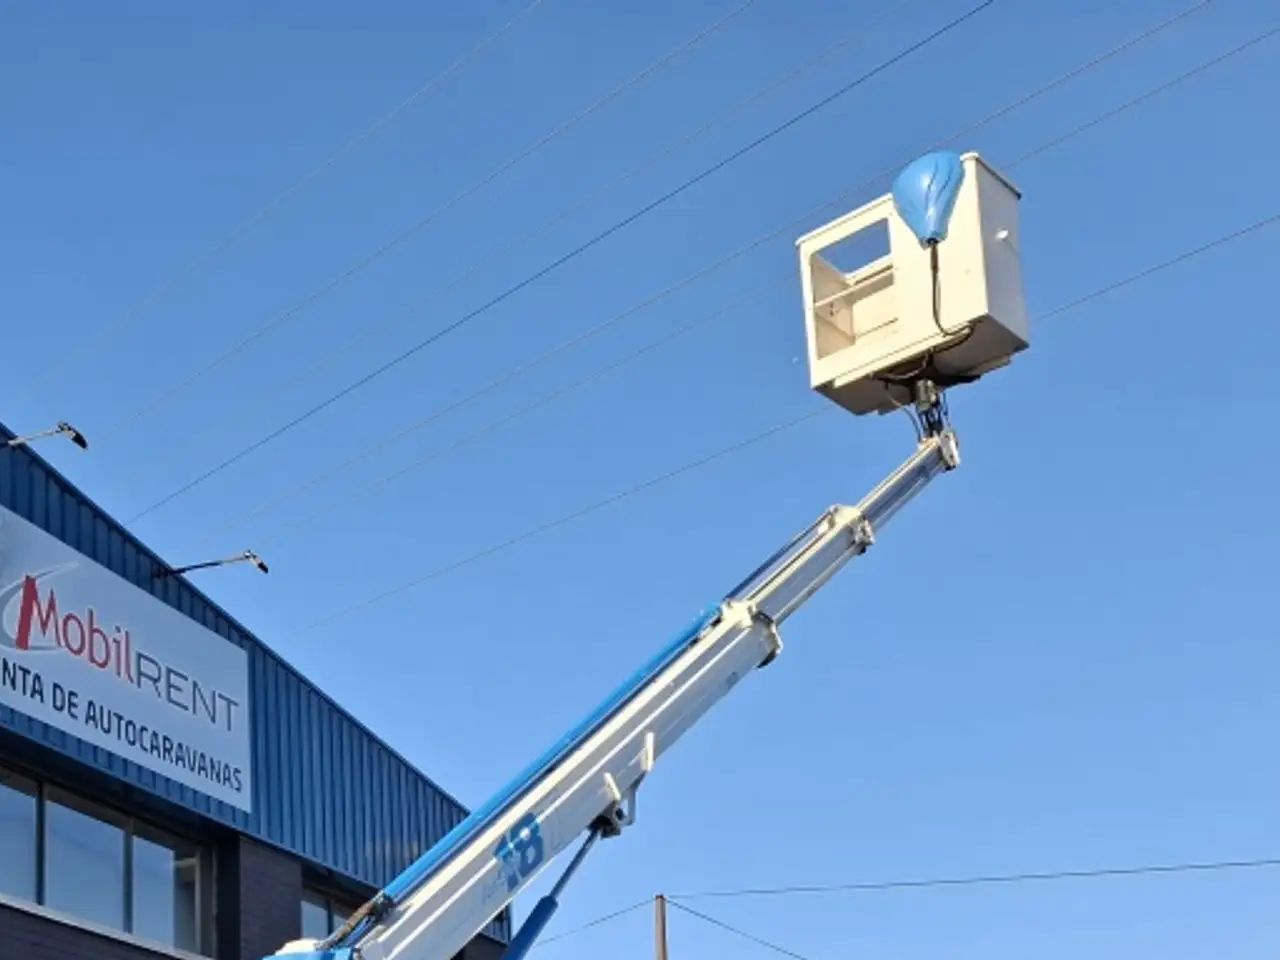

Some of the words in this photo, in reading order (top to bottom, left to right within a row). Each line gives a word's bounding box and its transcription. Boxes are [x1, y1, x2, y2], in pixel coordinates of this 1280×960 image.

[15, 575, 239, 731] MobilRENT
[52, 682, 79, 720] DE
[85, 699, 243, 793] AUTOCARAVANAS
